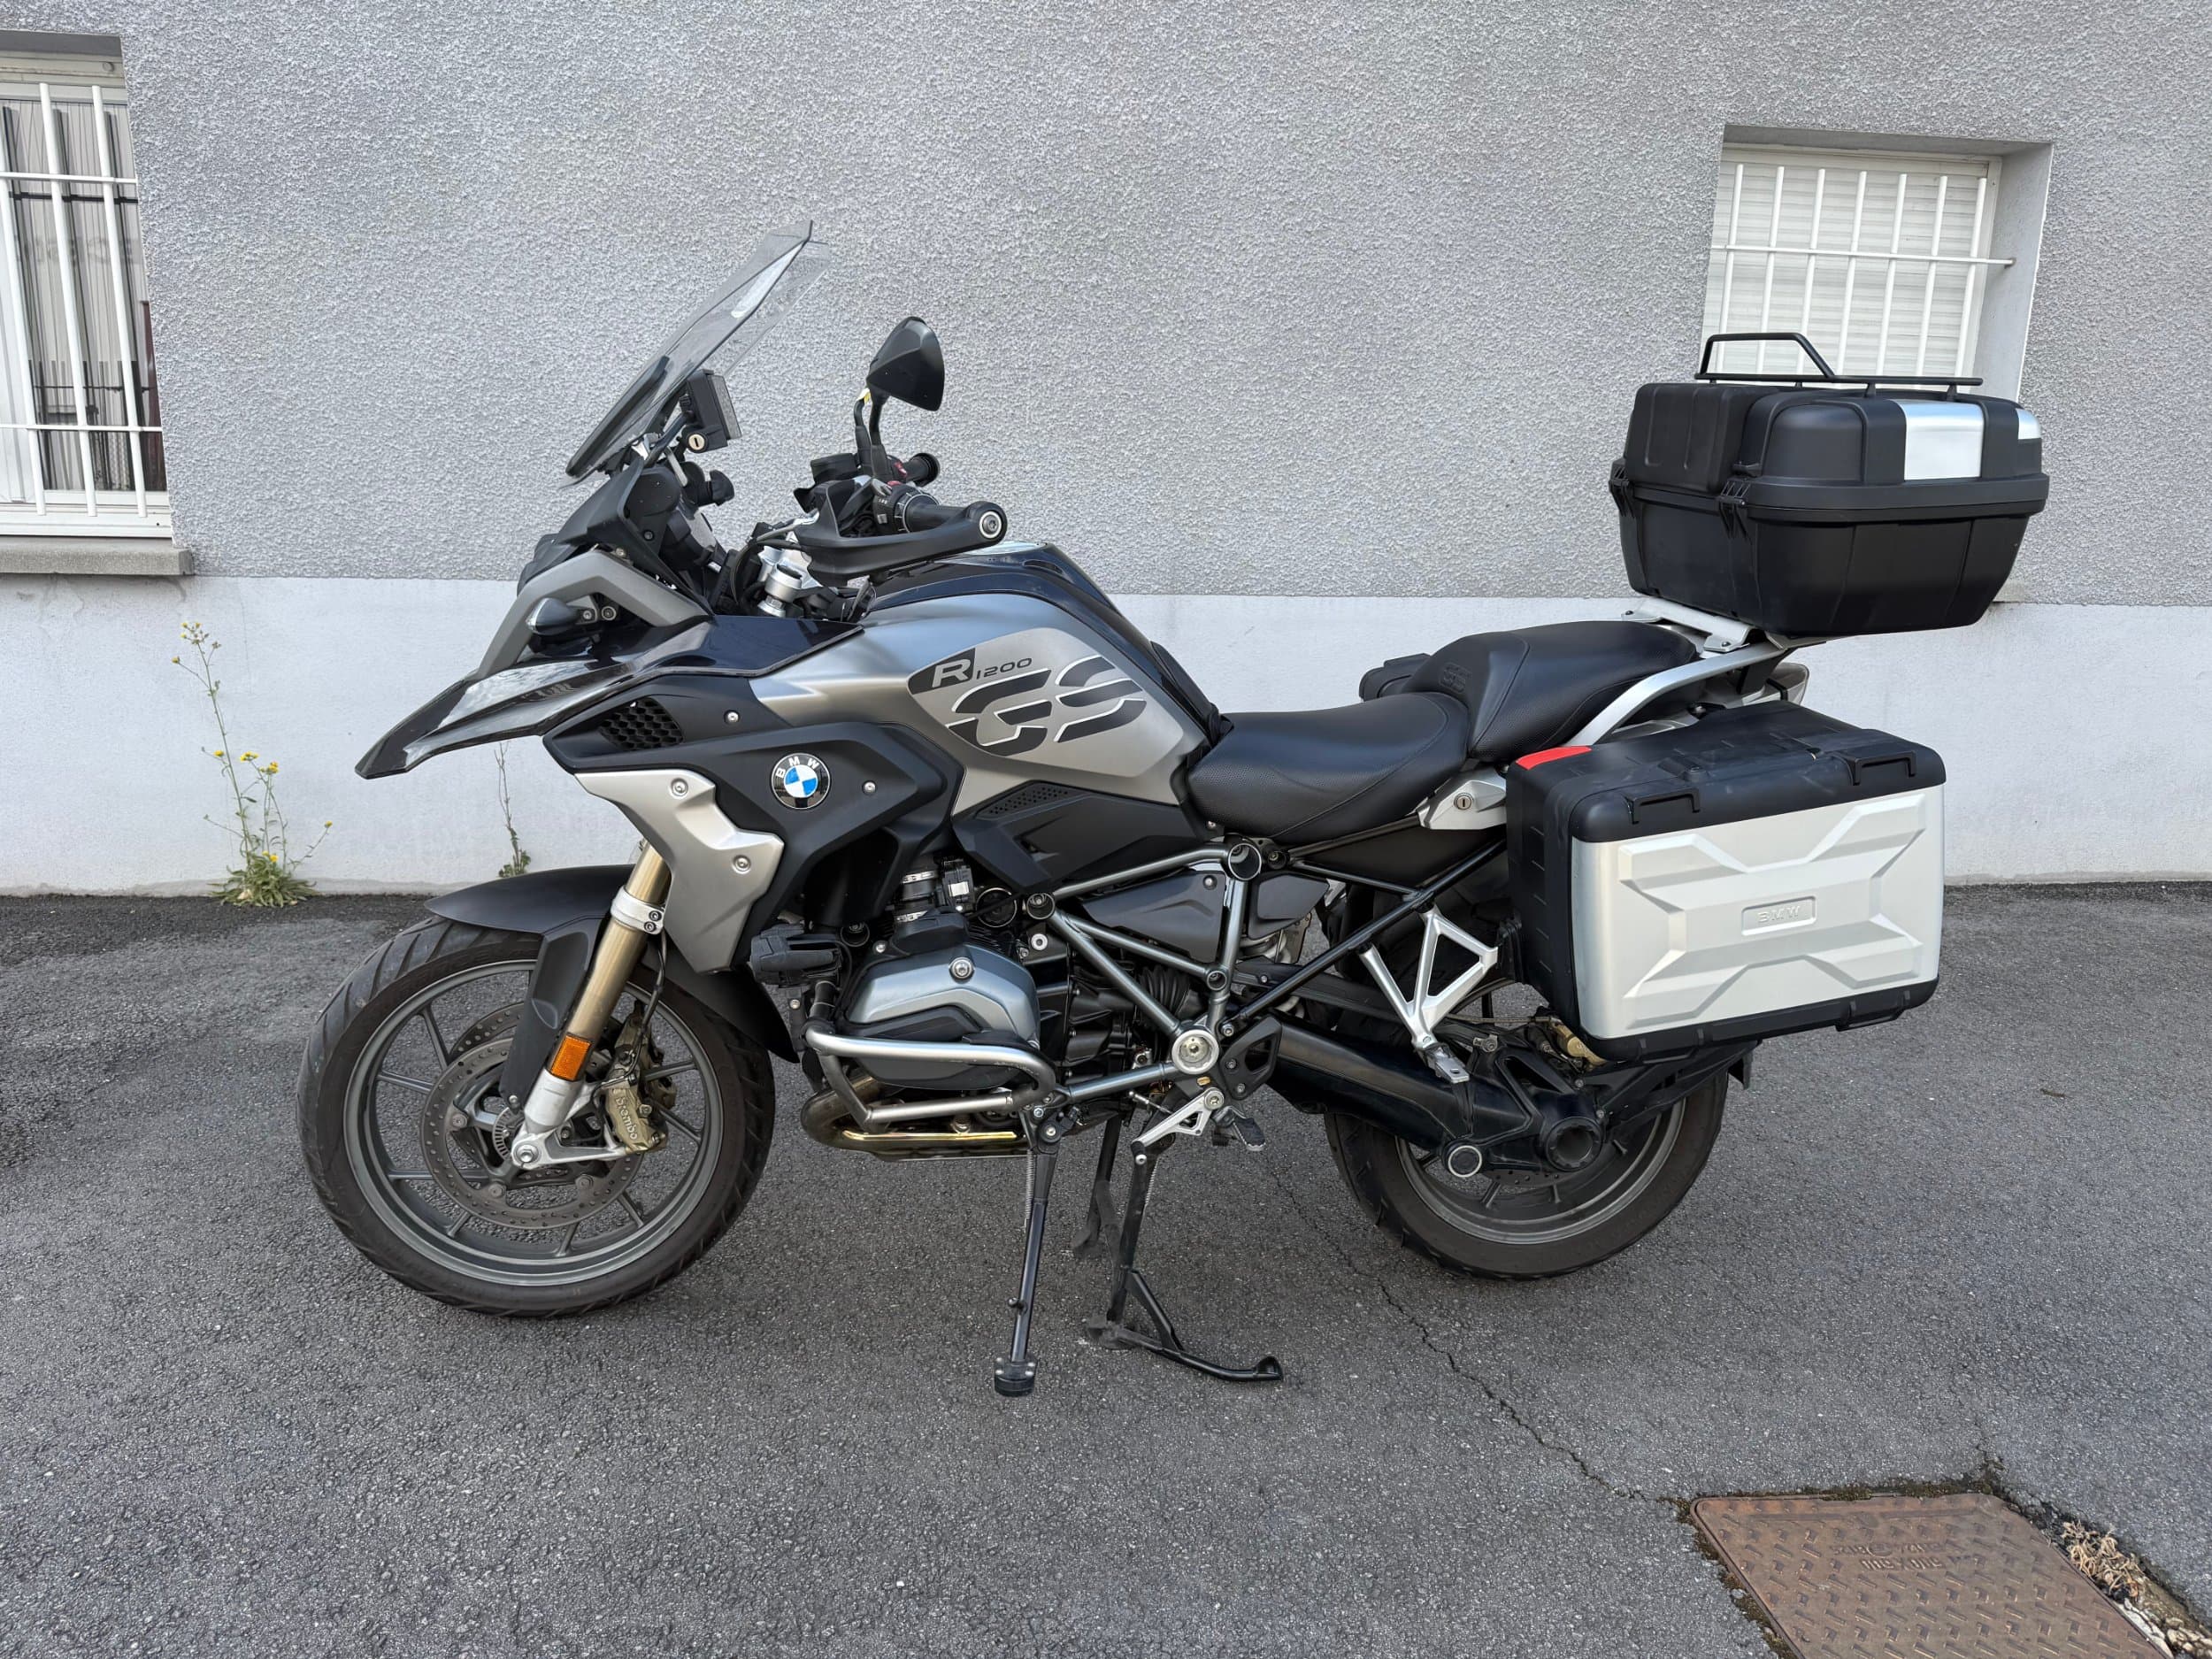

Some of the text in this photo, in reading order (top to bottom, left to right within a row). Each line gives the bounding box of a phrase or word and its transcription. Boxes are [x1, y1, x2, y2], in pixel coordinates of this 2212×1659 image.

[932, 657, 1033, 687] R 1200
[944, 654, 1148, 757] GS
[775, 756, 820, 779] BMW
[1757, 905, 1801, 923] BMW
[615, 1097, 637, 1140] brembo
